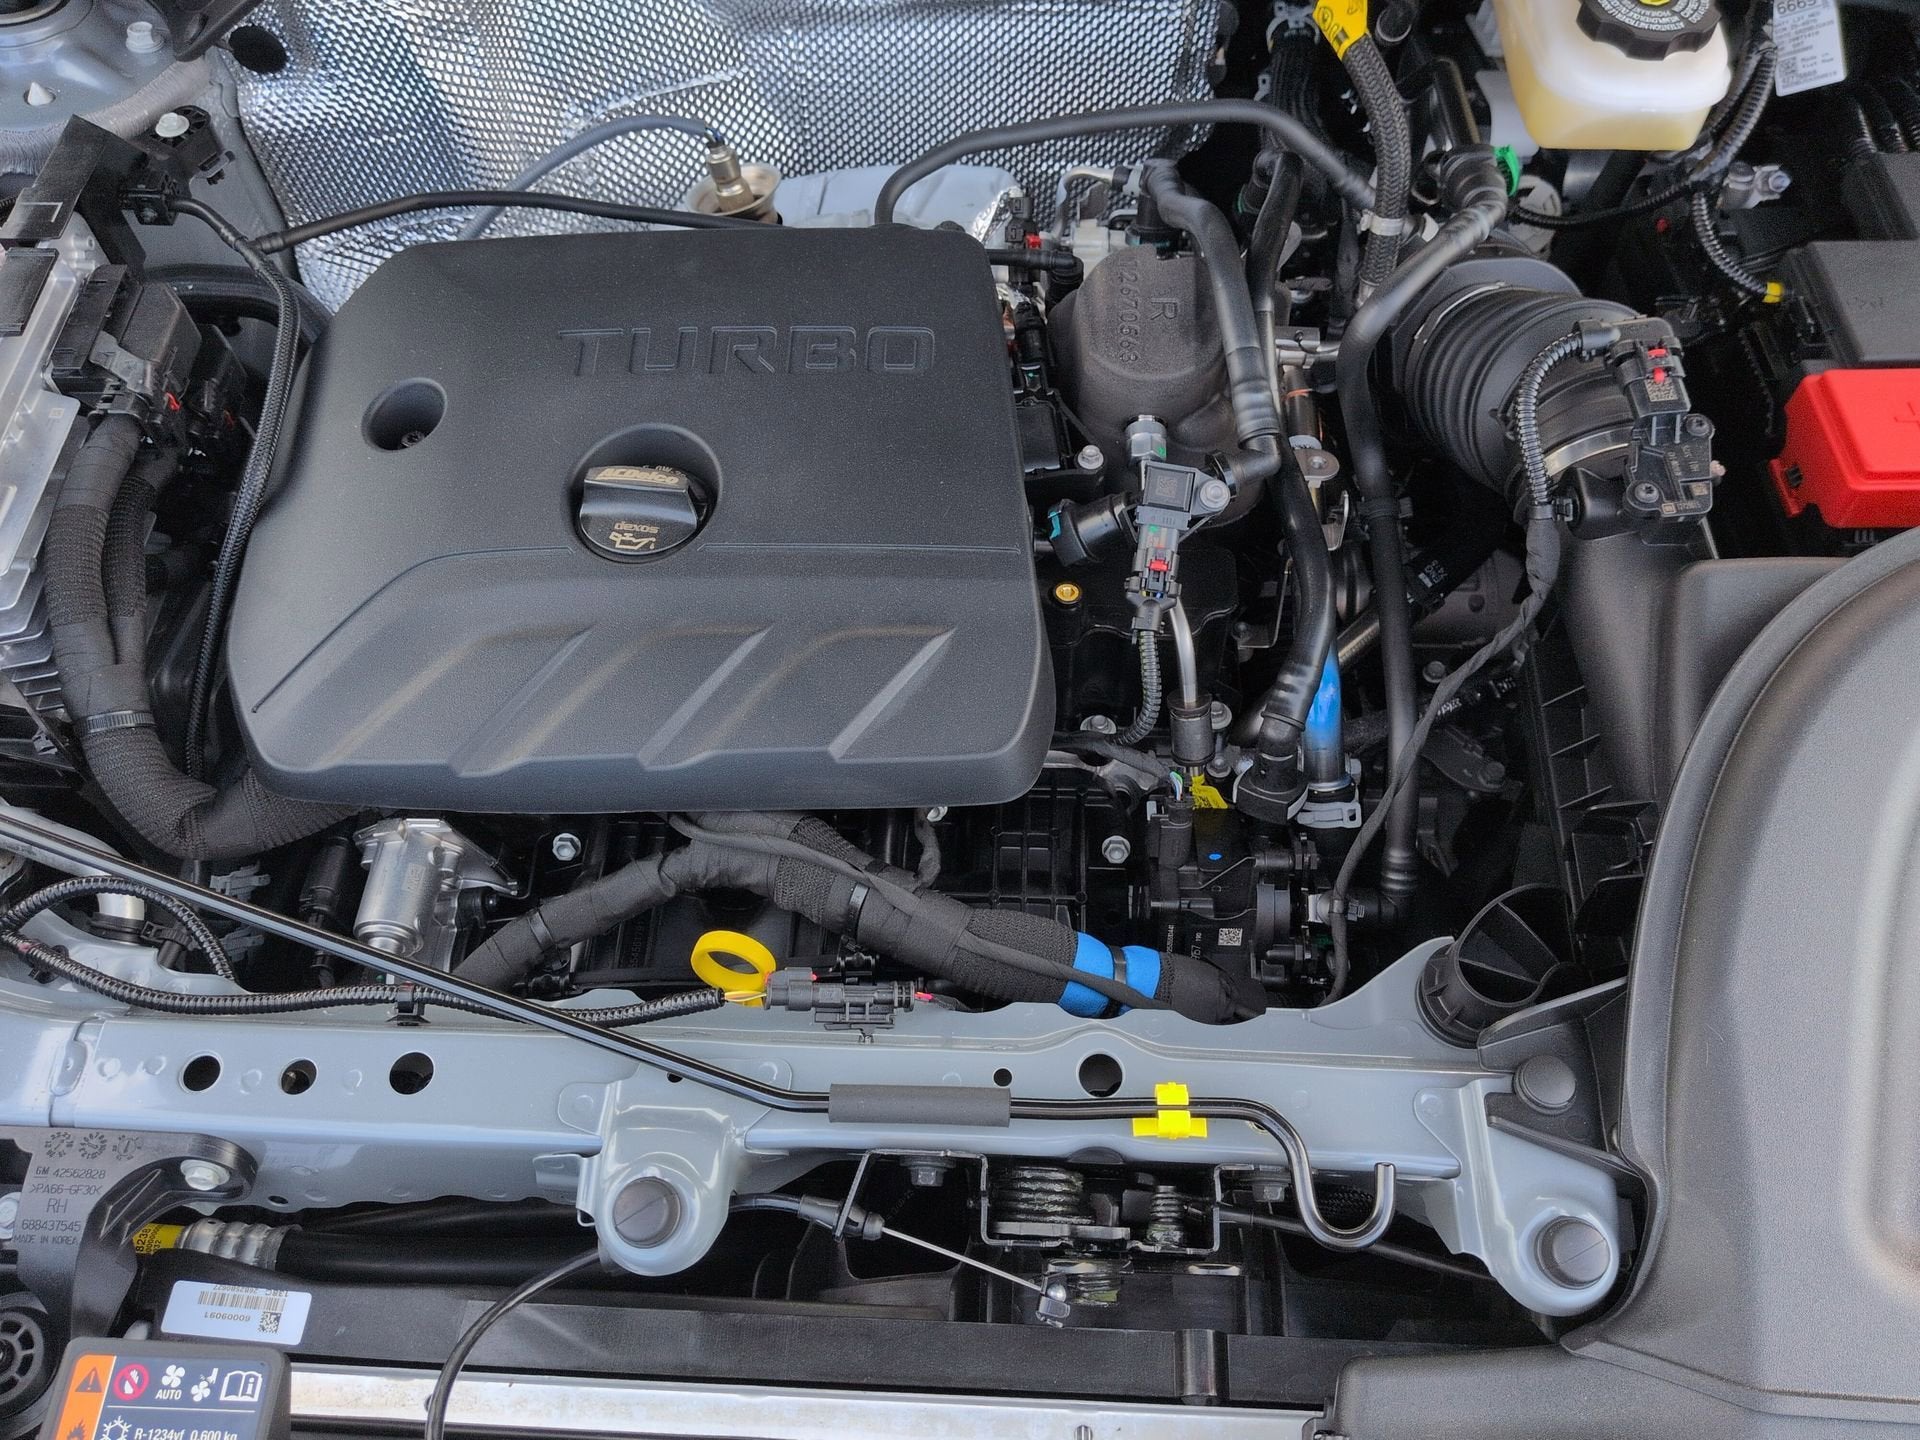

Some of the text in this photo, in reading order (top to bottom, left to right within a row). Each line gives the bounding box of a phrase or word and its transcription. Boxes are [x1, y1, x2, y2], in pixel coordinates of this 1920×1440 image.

[1150, 297, 1178, 321] R
[558, 325, 935, 376] TURBO
[596, 467, 679, 484] ACDelco
[614, 521, 660, 534] dexos
[35, 1166, 106, 1179] GM 42562828
[46, 1198, 69, 1213] RH
[13, 1234, 77, 1246] MADE IN KOREA
[155, 1389, 183, 1400] AUTO
[134, 1428, 186, 1440] R-1234yf
